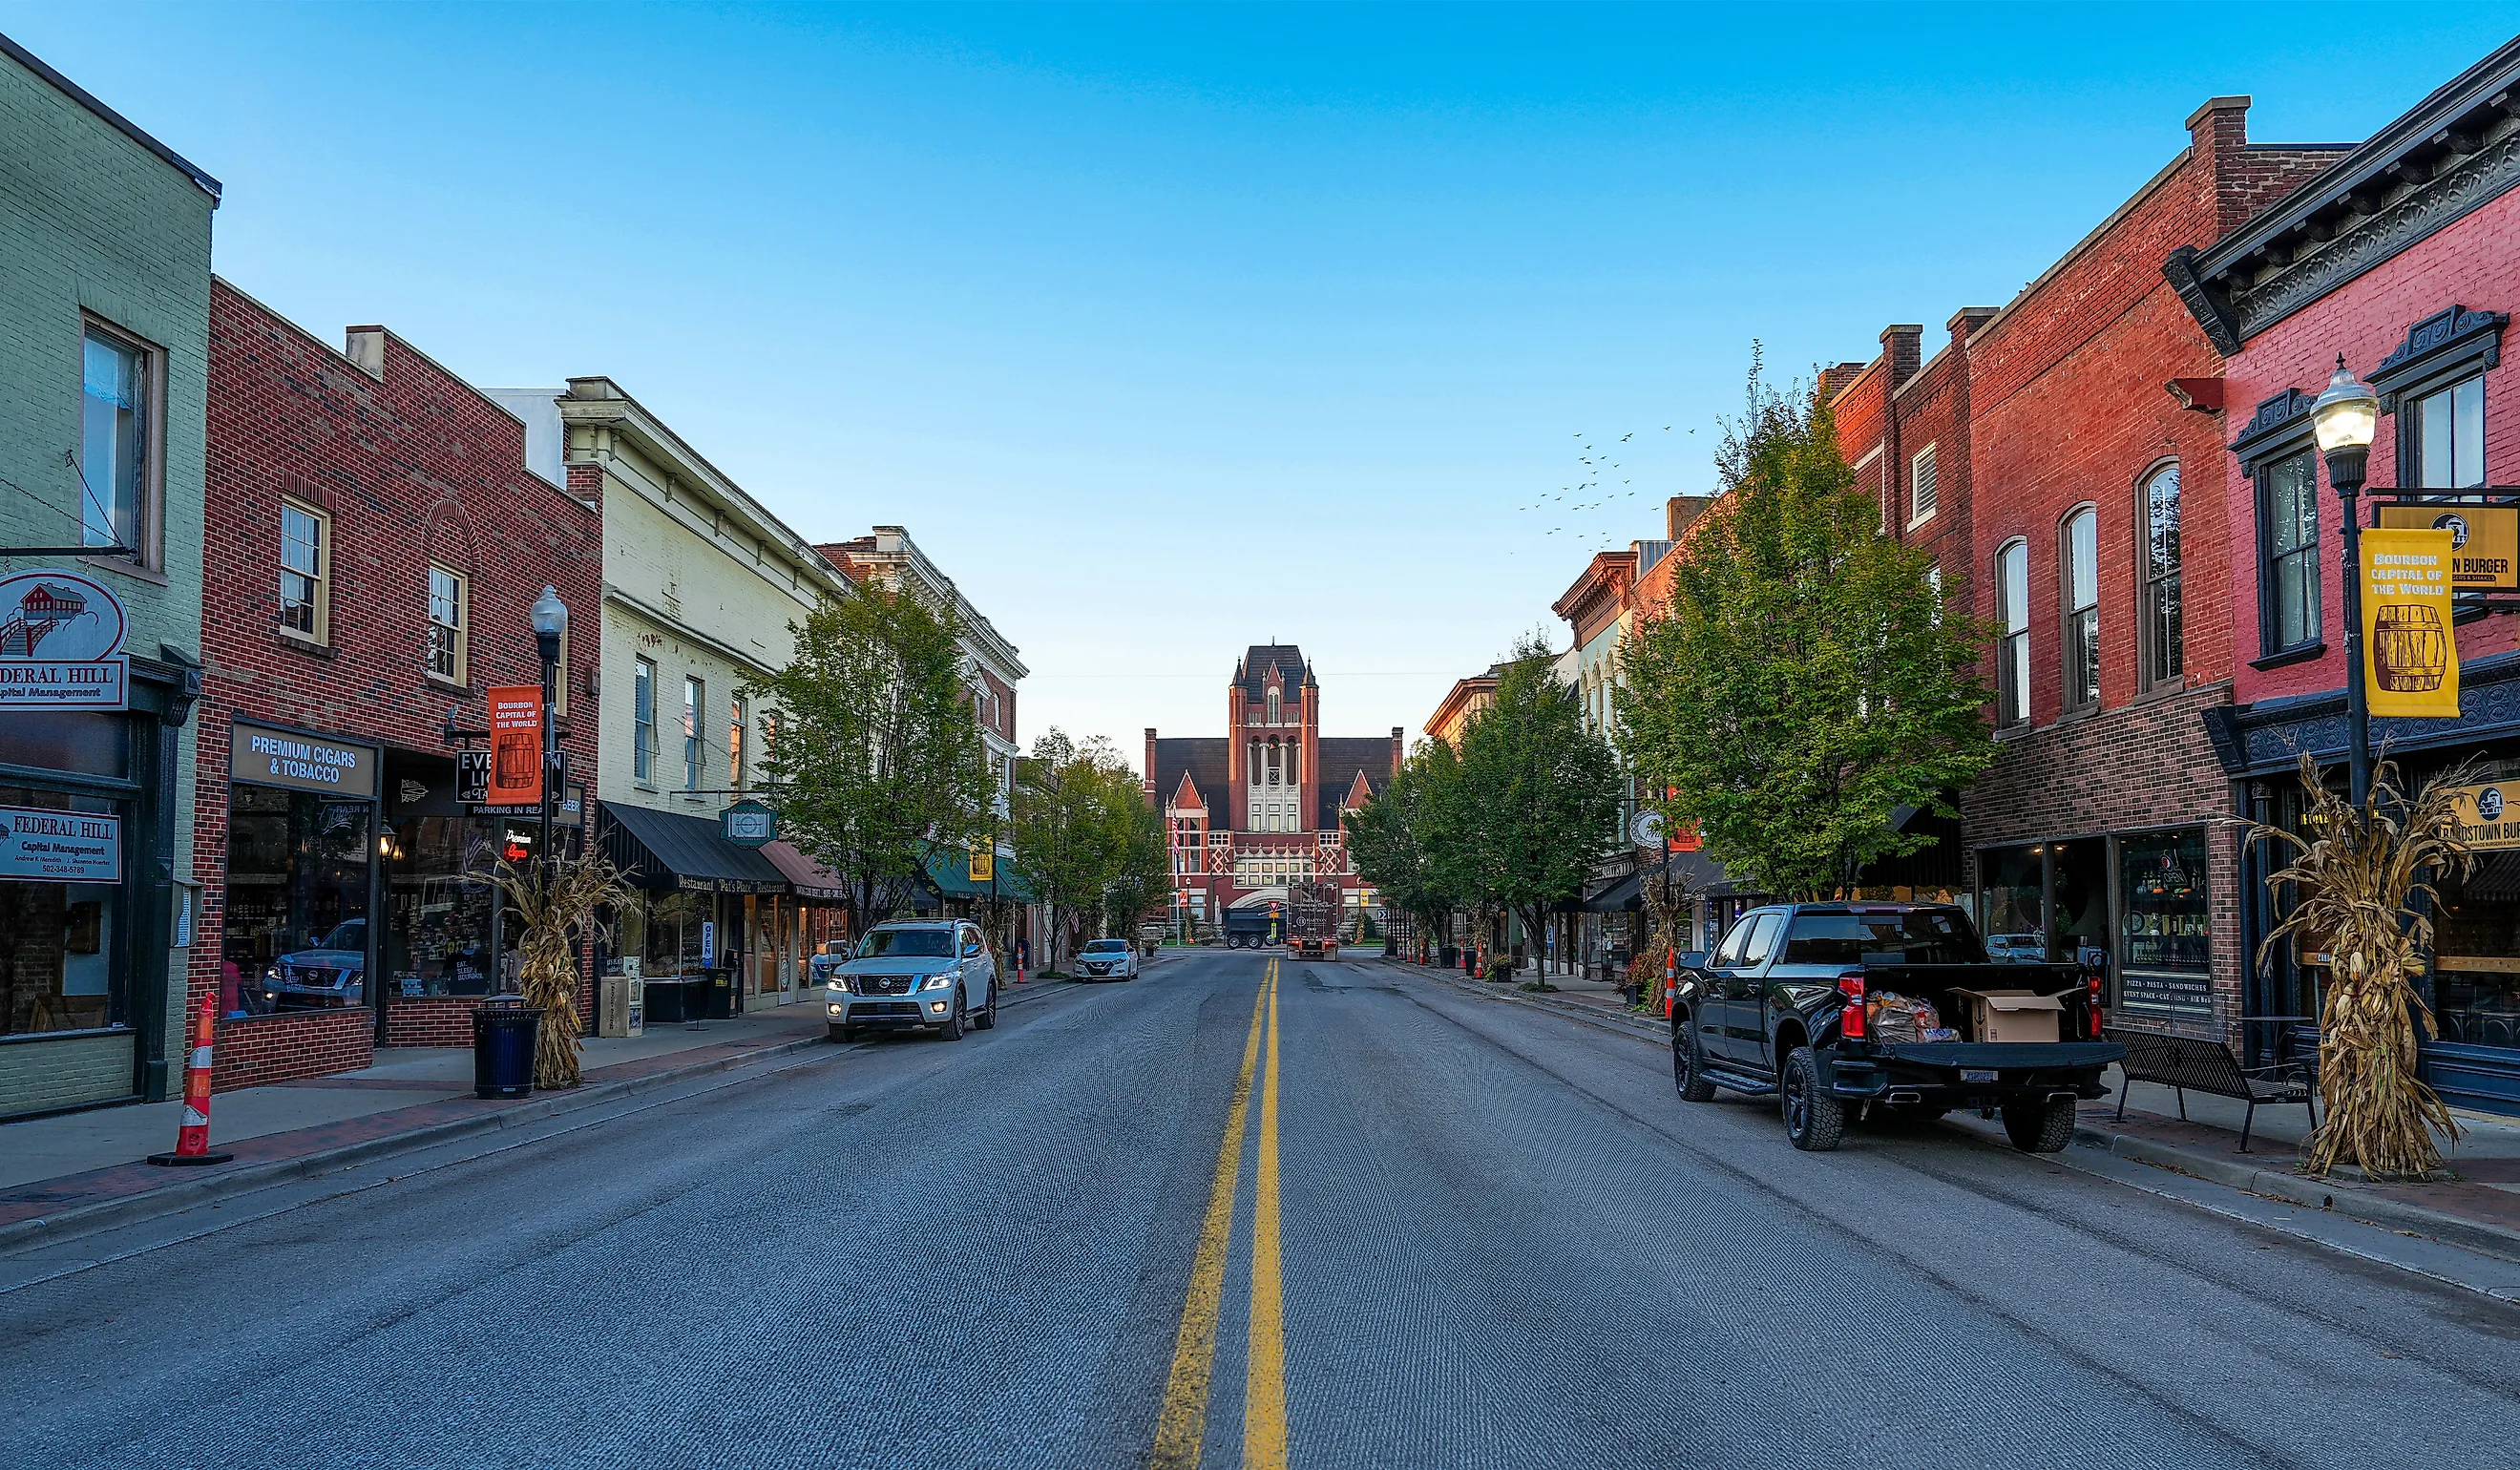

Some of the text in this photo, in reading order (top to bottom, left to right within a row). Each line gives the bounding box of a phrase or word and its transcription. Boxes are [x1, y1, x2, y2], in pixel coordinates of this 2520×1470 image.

[2374, 554, 2437, 565] BOURBON
[2464, 558, 2509, 573] BURGER
[2371, 569, 2443, 580] CAPITAL OF
[2372, 584, 2395, 595] THE
[0, 667, 114, 683] DERAL HILL
[0, 687, 101, 699] pital Management
[251, 735, 356, 768] PREMIUM CIGARS
[270, 758, 340, 783] & TOBACCO
[472, 806, 542, 814] PARKING IN REA
[13, 815, 113, 840] FEDERAL HILL
[2444, 823, 2501, 842] BADSTOWN
[21, 841, 105, 856] Capital Management
[42, 865, 85, 874] 502-348-5789
[679, 874, 714, 891] Restaurant
[757, 882, 786, 892] Restaurant
[2169, 982, 2206, 992] SANDWICHES
